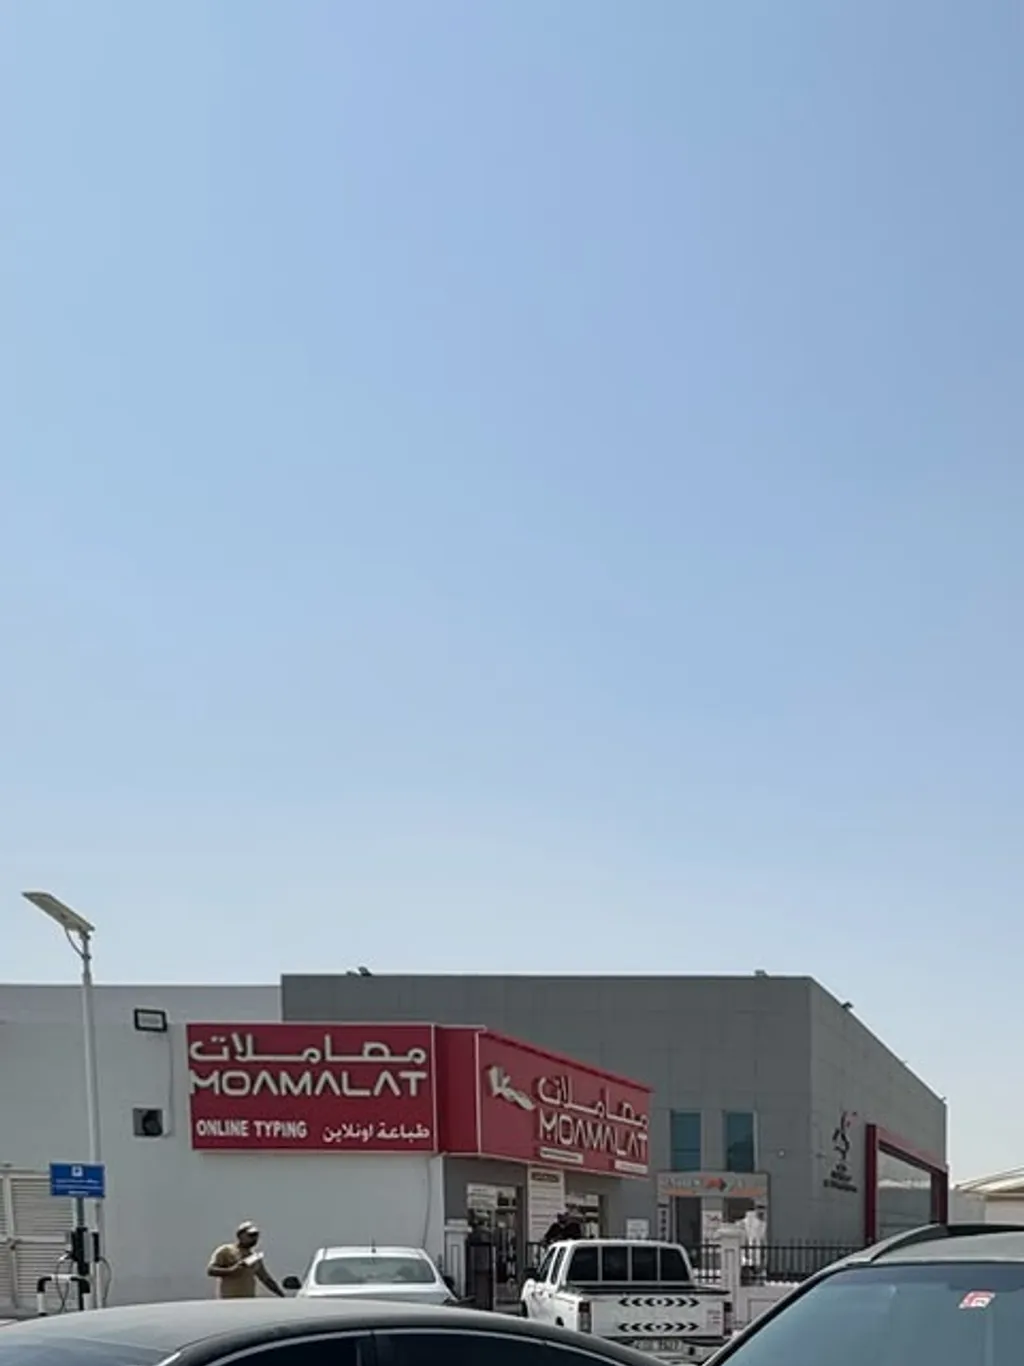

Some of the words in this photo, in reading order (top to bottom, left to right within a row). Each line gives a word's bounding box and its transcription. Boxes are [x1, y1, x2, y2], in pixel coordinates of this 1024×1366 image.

[189, 1070, 427, 1096] MOAMALAT
[196, 1120, 249, 1138] ONLINE
[254, 1120, 308, 1139] TYPING
[376, 1122, 431, 1143] طباعة
[540, 1108, 648, 1161] MOAMALAT
